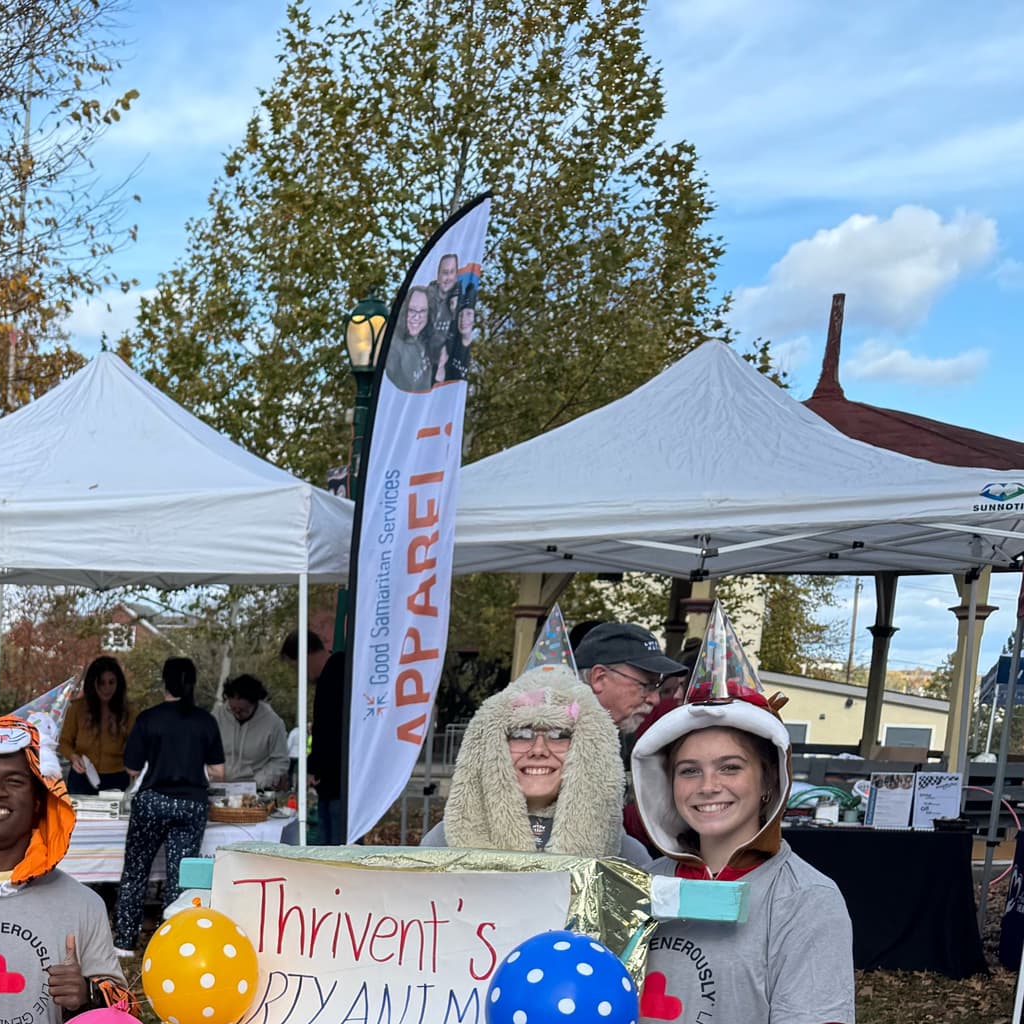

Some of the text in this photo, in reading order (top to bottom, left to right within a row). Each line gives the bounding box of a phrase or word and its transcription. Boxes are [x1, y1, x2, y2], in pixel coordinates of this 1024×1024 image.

[369, 469, 401, 686] Good Samaritan Services
[232, 877, 497, 981] Thrivent's
[648, 936, 717, 1005] ENEROUSLY
